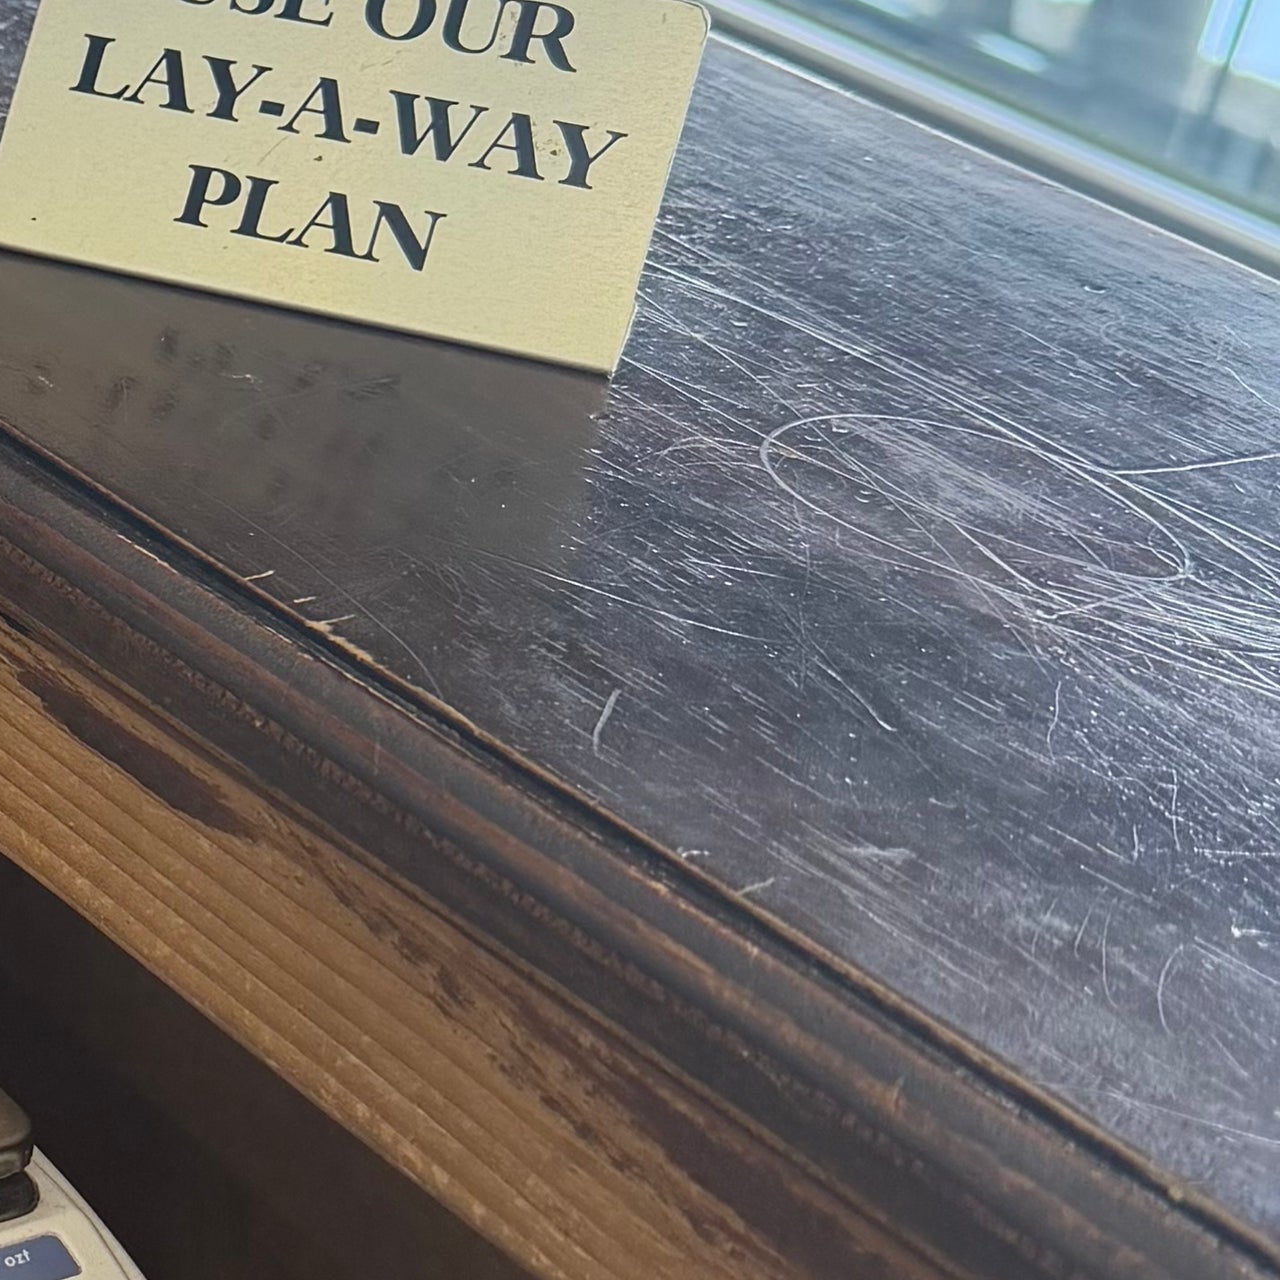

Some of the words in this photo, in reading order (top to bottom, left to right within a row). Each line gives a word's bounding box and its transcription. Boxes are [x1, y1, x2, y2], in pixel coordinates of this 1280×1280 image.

[69, 34, 628, 190] LAY-A-WAY
[173, 163, 448, 272] PLAN
[4, 1248, 31, 1268] ozt
